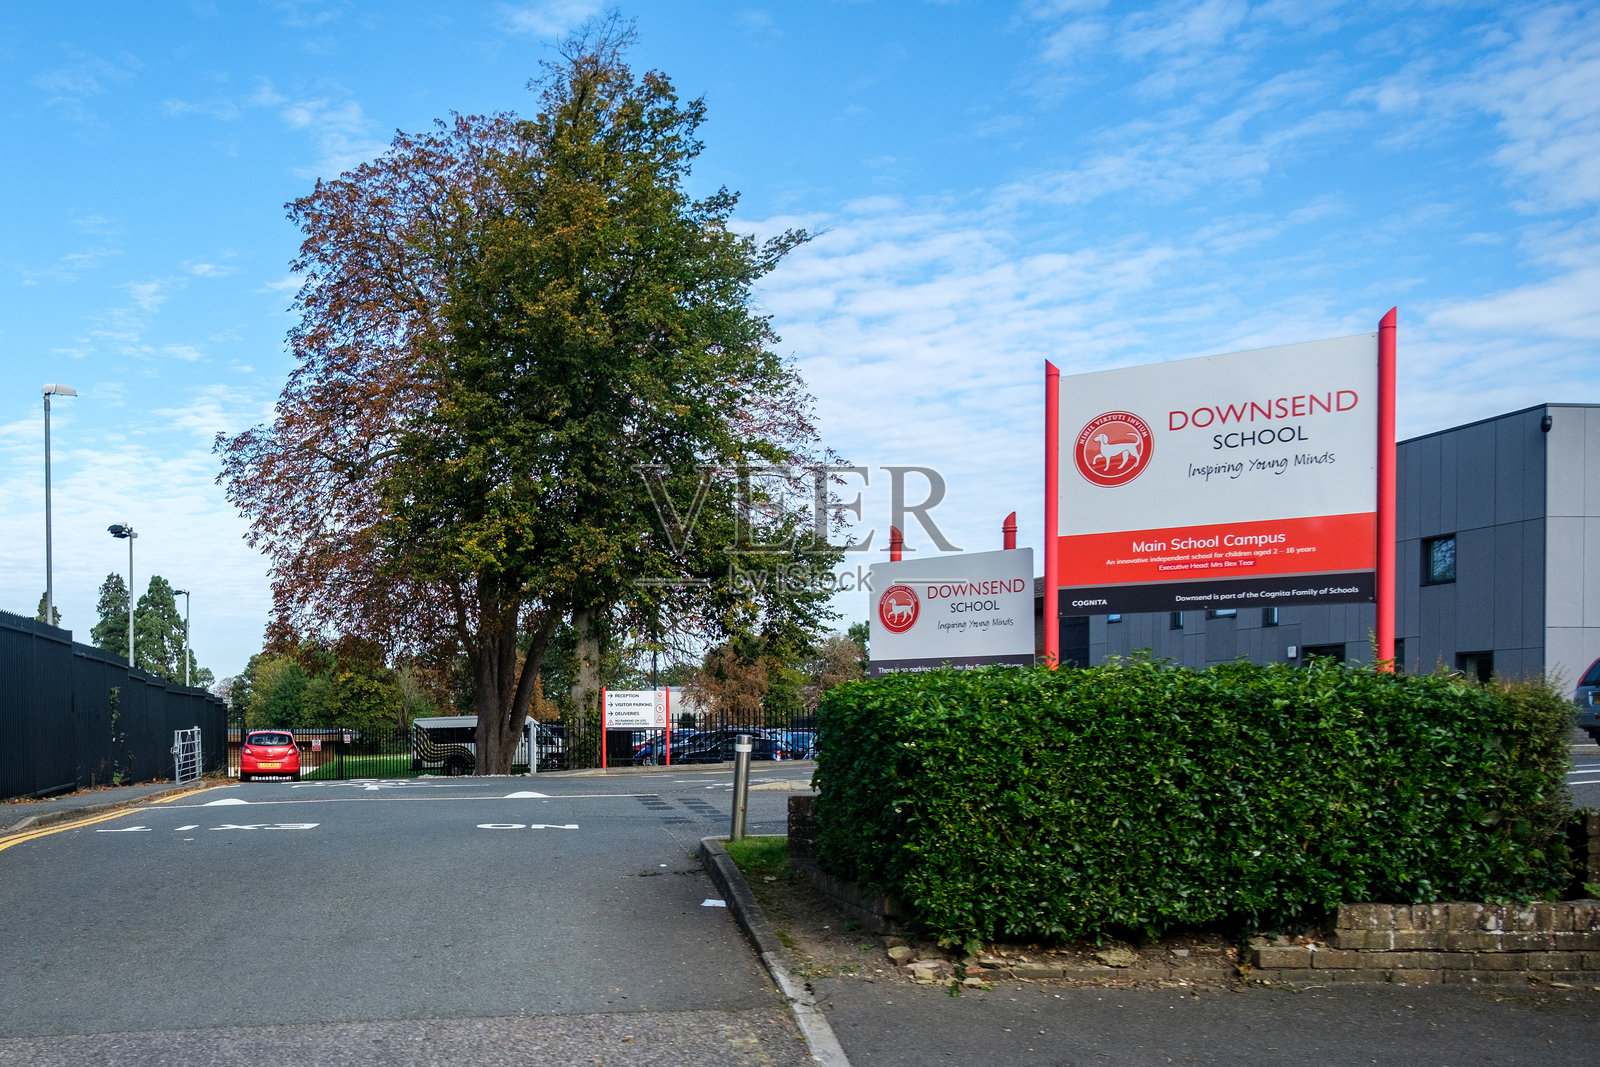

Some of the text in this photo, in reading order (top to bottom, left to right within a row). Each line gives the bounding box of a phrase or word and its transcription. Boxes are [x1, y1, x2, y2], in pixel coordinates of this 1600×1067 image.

[1168, 390, 1359, 431] DOWNSEND
[1079, 414, 1149, 445] NIHIL VIRTUTI INVIUM
[1213, 426, 1309, 450] SCHOOL
[1188, 452, 1336, 482] Inspiring Young Minds
[1132, 533, 1286, 553] Main School Campus
[1116, 557, 1149, 565] innovative
[1150, 554, 1190, 564] independent
[1191, 552, 1213, 560] school
[1225, 549, 1252, 558] children
[1253, 548, 1272, 557] aged
[1296, 546, 1317, 554] years
[1159, 563, 1189, 571] Executive
[927, 579, 1026, 600] DOWNSEND
[1175, 594, 1212, 602] Downsend
[1220, 592, 1236, 601] part
[1237, 591, 1246, 599] of
[1260, 589, 1291, 599] Cognita
[1291, 588, 1318, 598] Family
[1329, 586, 1359, 594] Schools
[950, 600, 1000, 613] SCHOOL
[1072, 599, 1108, 607] COGNITA
[937, 617, 1014, 634] Inspiring Young Minds
